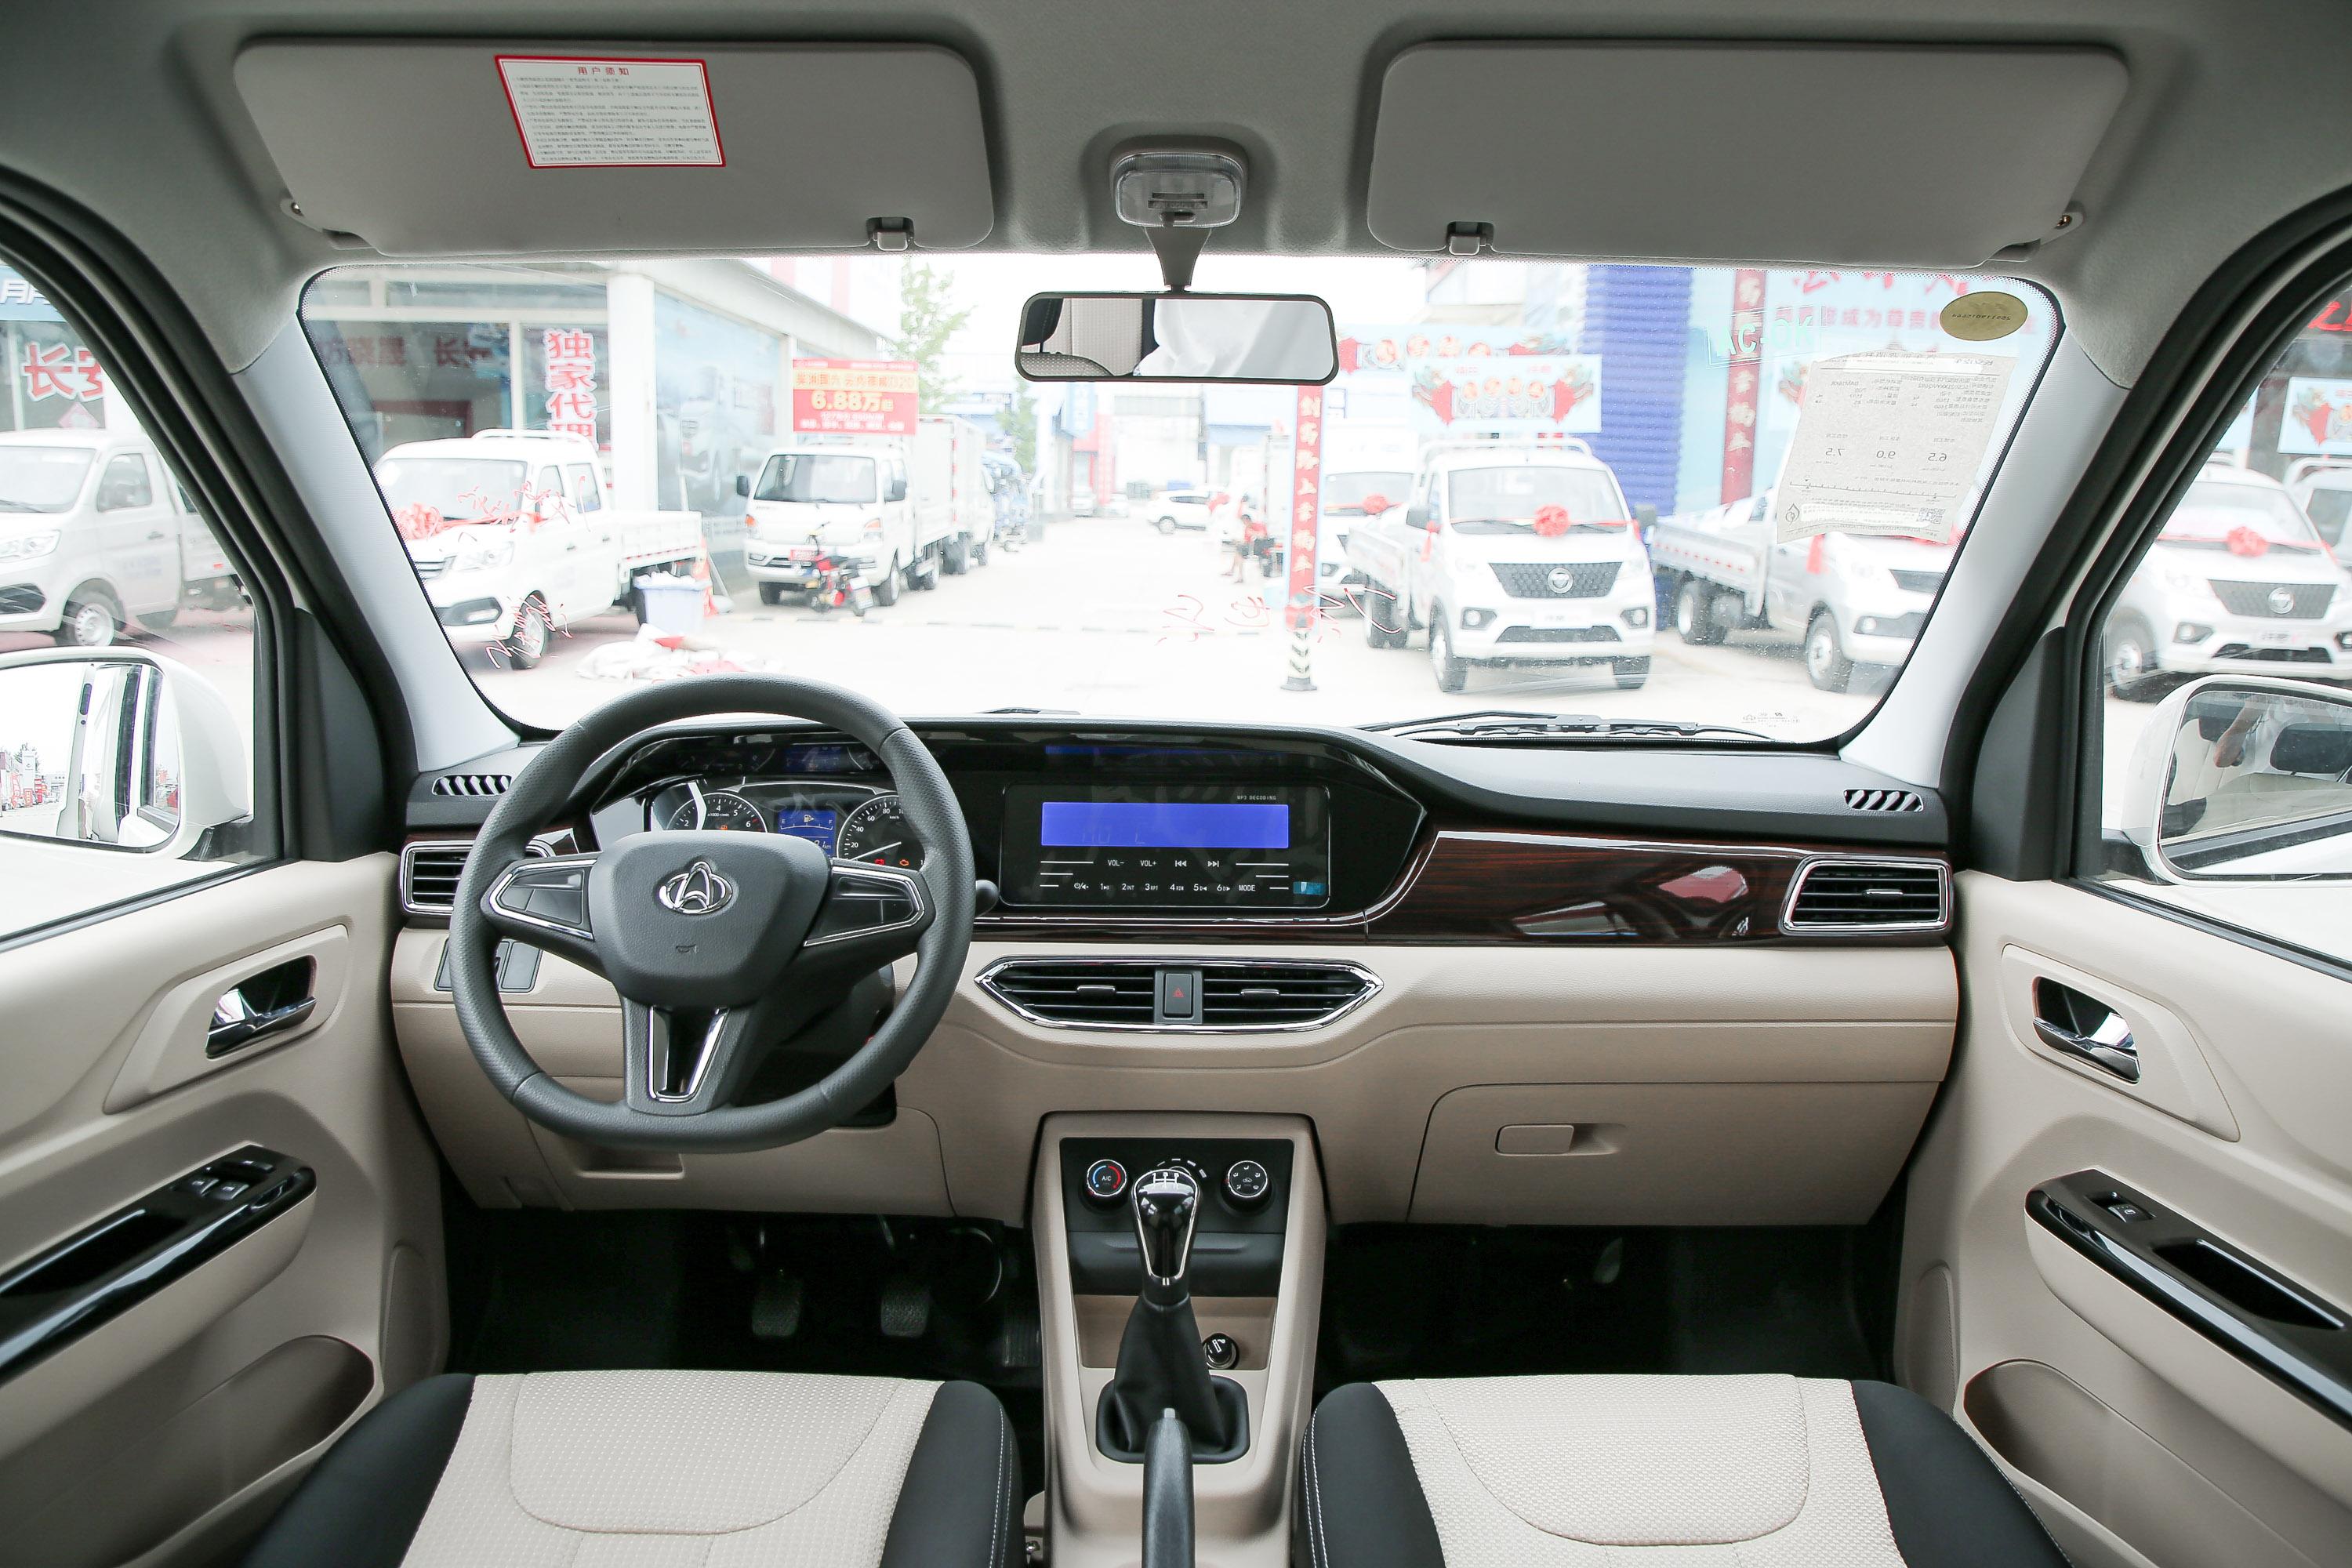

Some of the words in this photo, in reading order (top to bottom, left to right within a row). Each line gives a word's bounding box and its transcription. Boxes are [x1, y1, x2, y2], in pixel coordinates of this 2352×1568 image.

[578, 67, 630, 76] 用户须知
[1715, 315, 1816, 357] AC-OK
